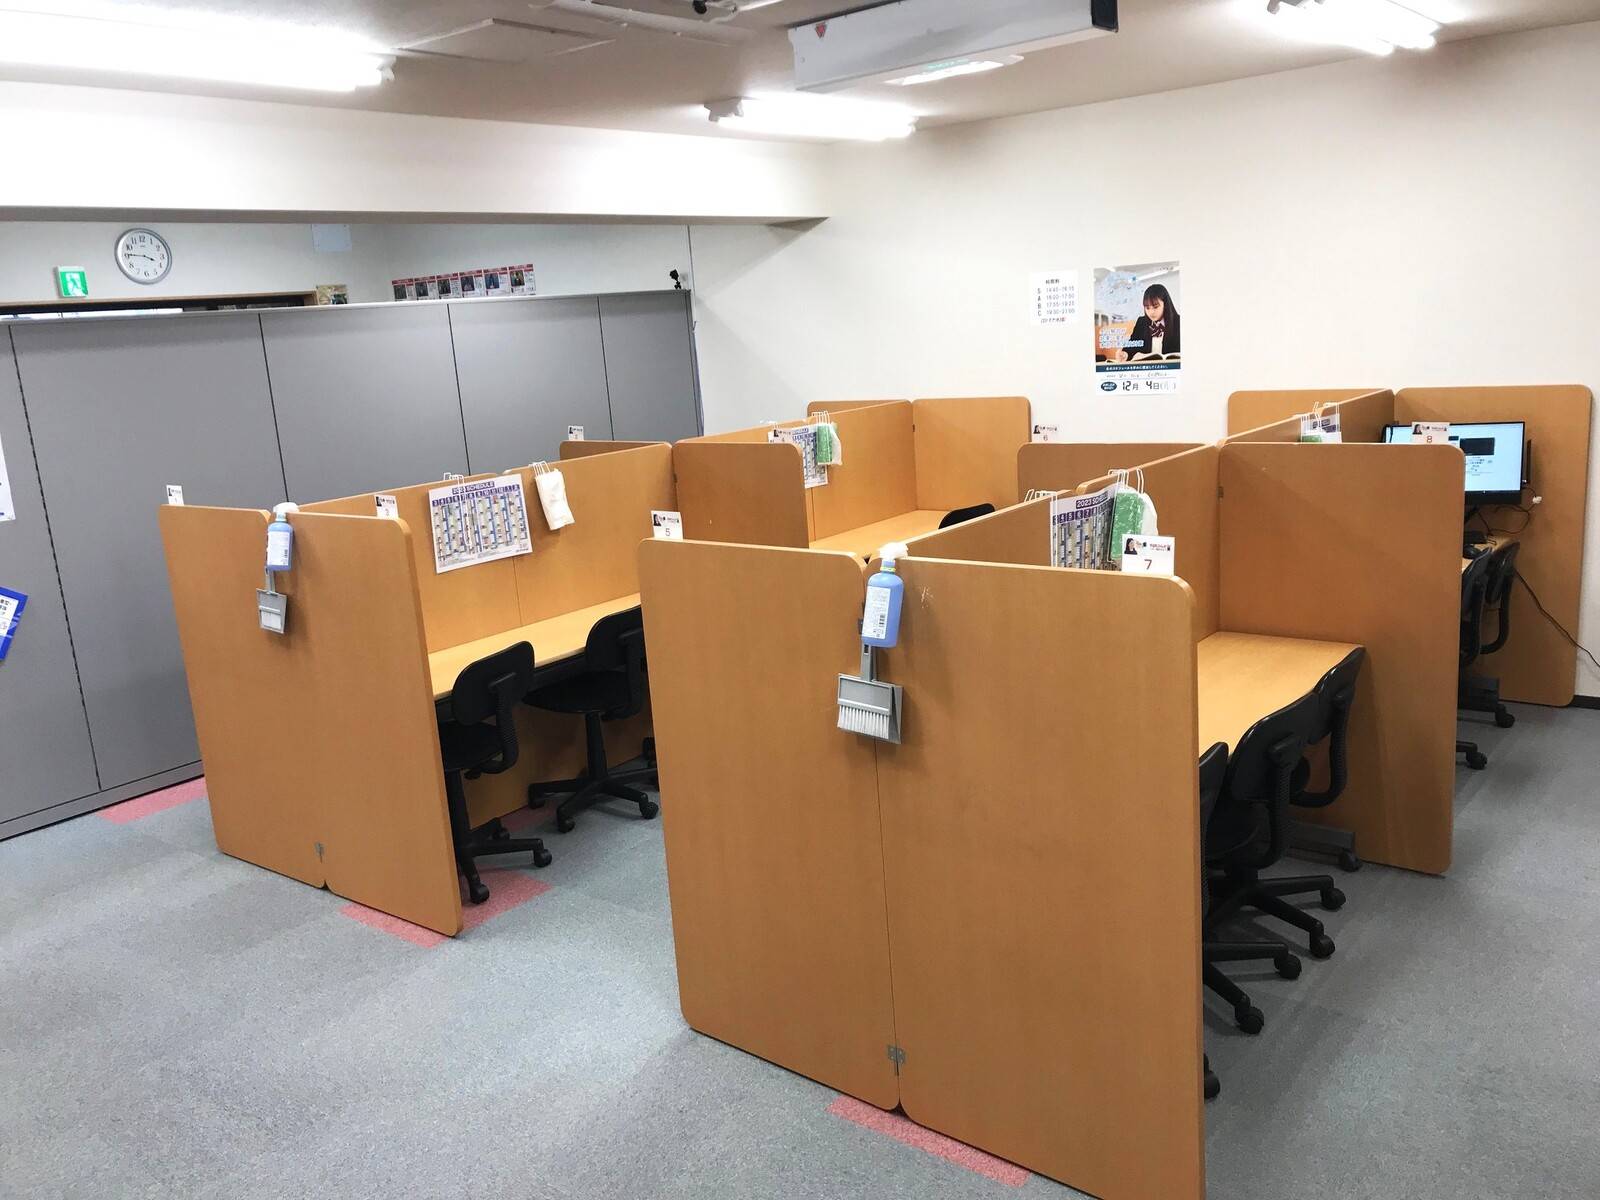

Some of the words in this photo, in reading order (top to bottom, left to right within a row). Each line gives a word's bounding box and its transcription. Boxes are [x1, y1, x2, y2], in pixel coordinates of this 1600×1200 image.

[1426, 435, 1433, 443] 8
[1077, 500, 1092, 508] 2023
[665, 527, 671, 537] 5
[1144, 559, 1153, 571] 7
